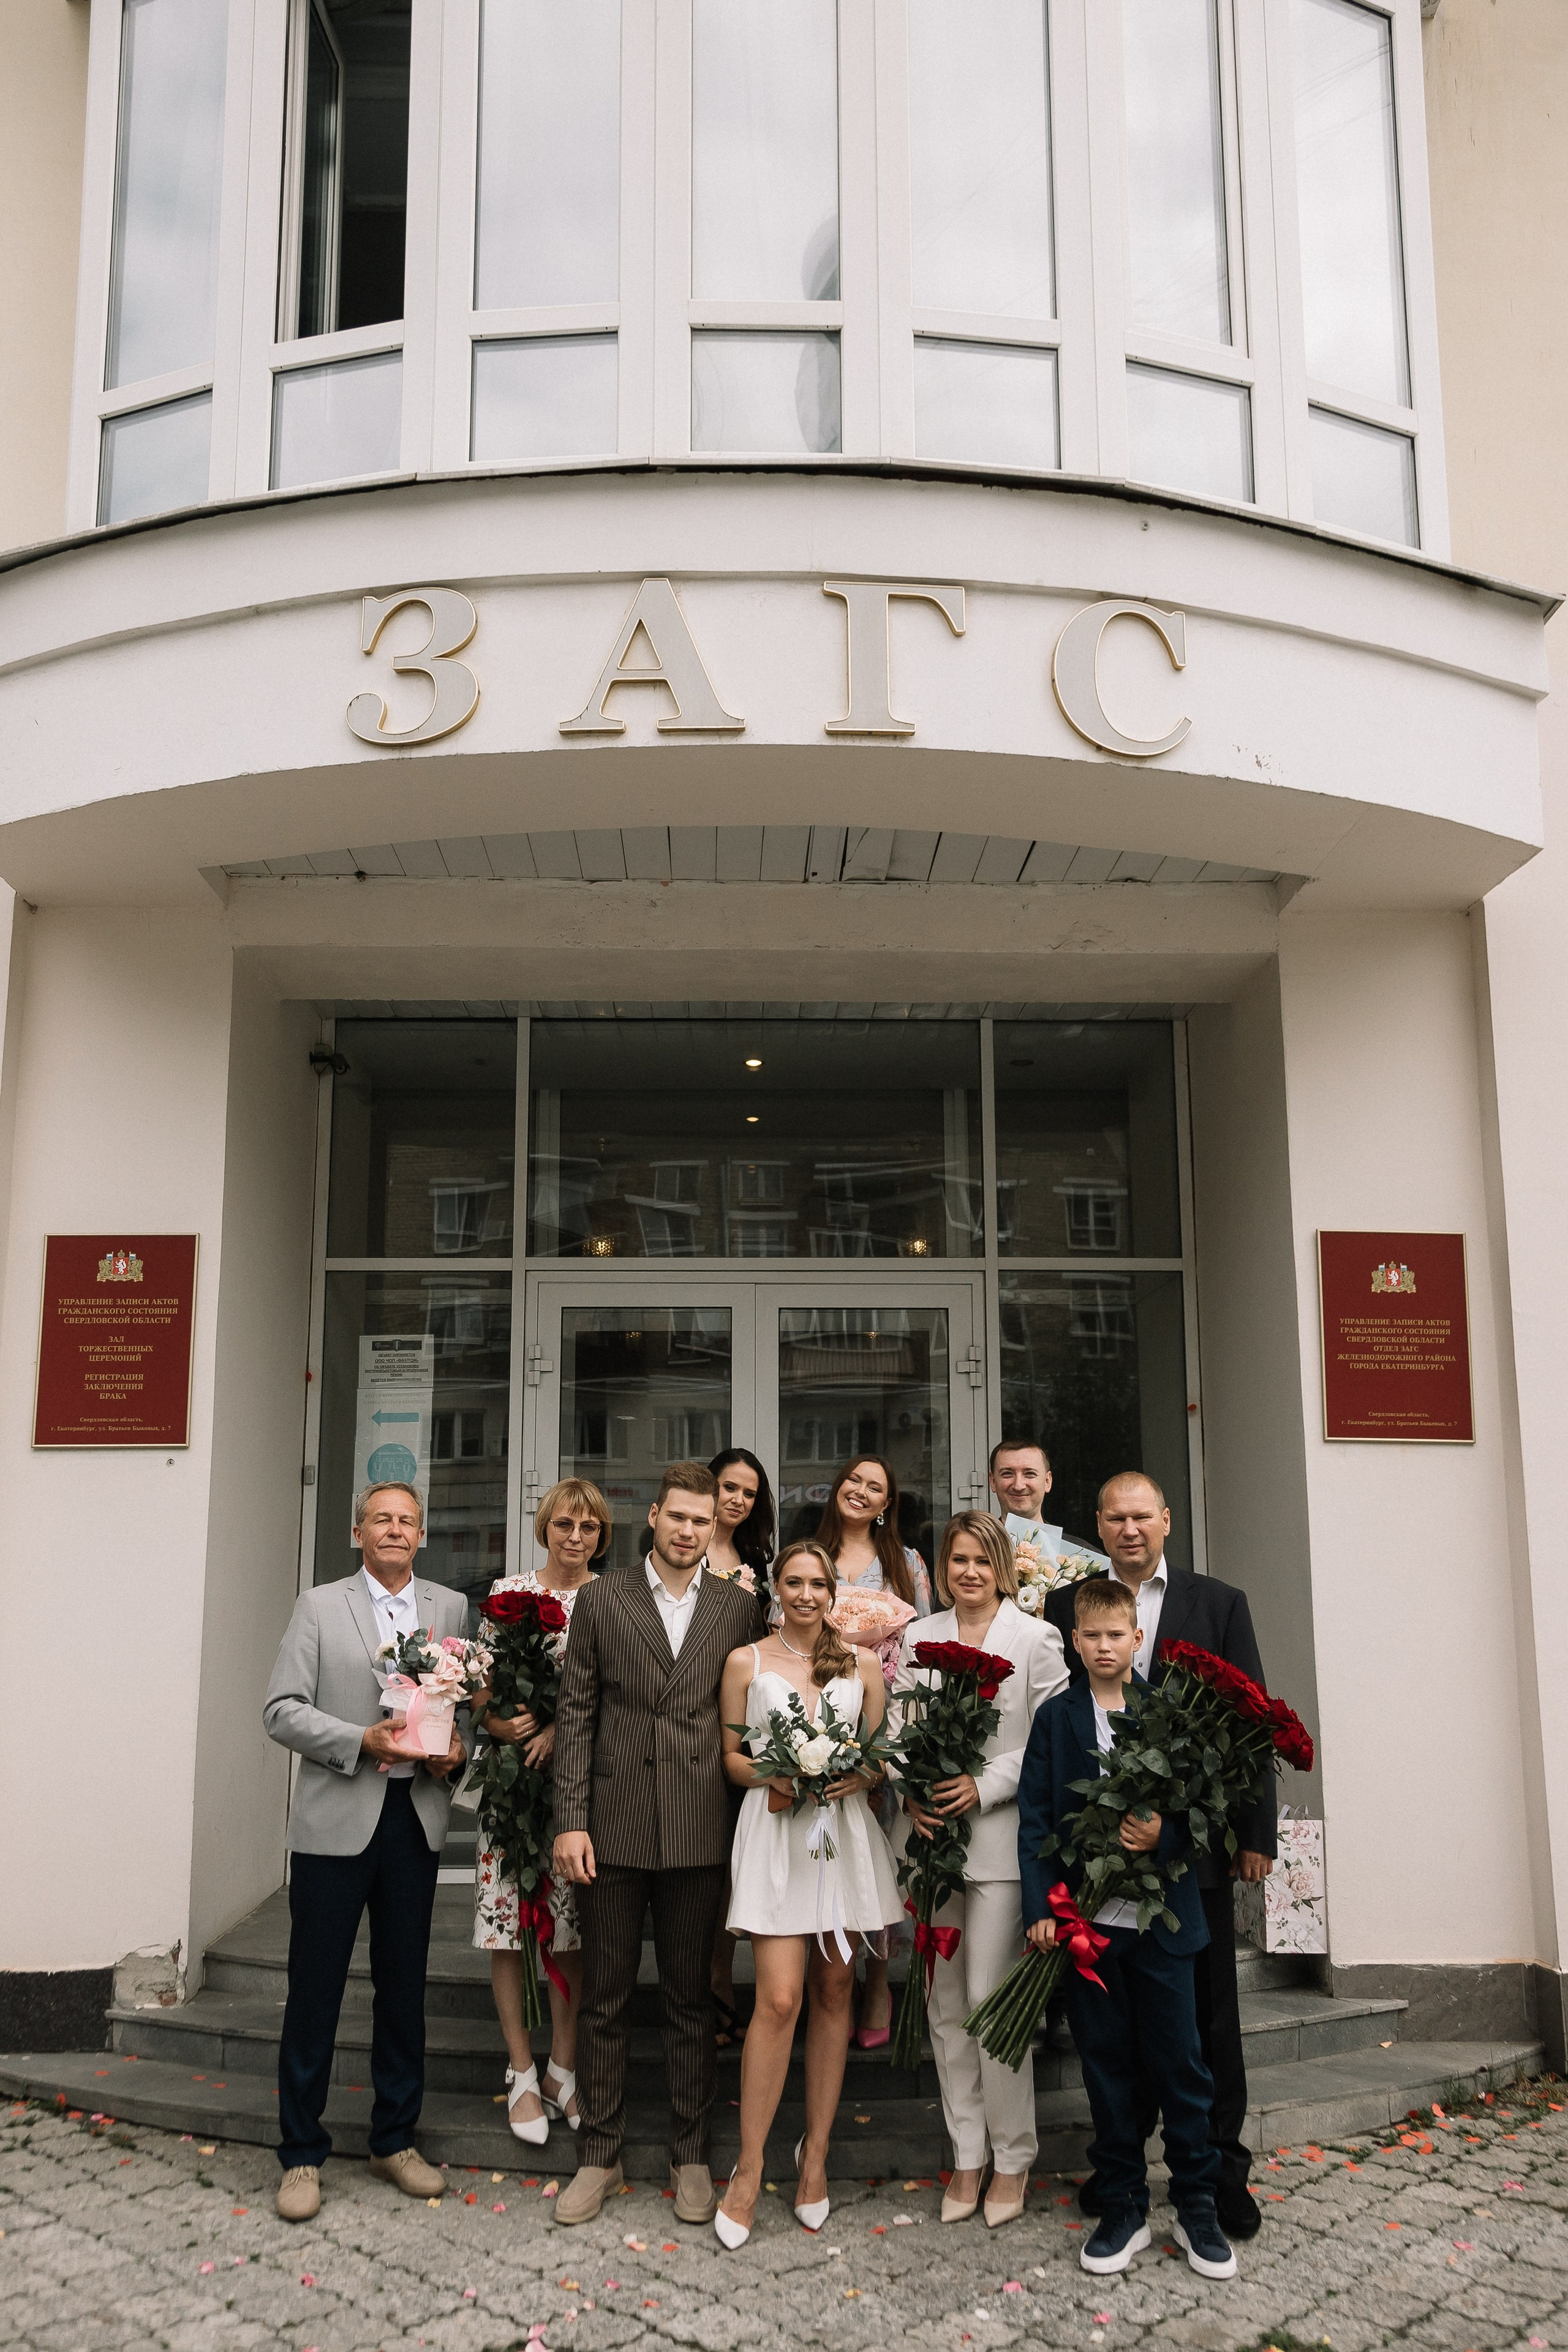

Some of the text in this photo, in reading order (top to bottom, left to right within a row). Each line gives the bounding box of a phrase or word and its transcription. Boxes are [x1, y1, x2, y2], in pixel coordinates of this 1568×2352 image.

[345, 578, 1192, 757] ЗАГС
[1346, 1335, 1408, 1344] СВЕРДЛОВСКОЙ
[89, 1354, 141, 1362] ЦЕРЕМОНИЙ
